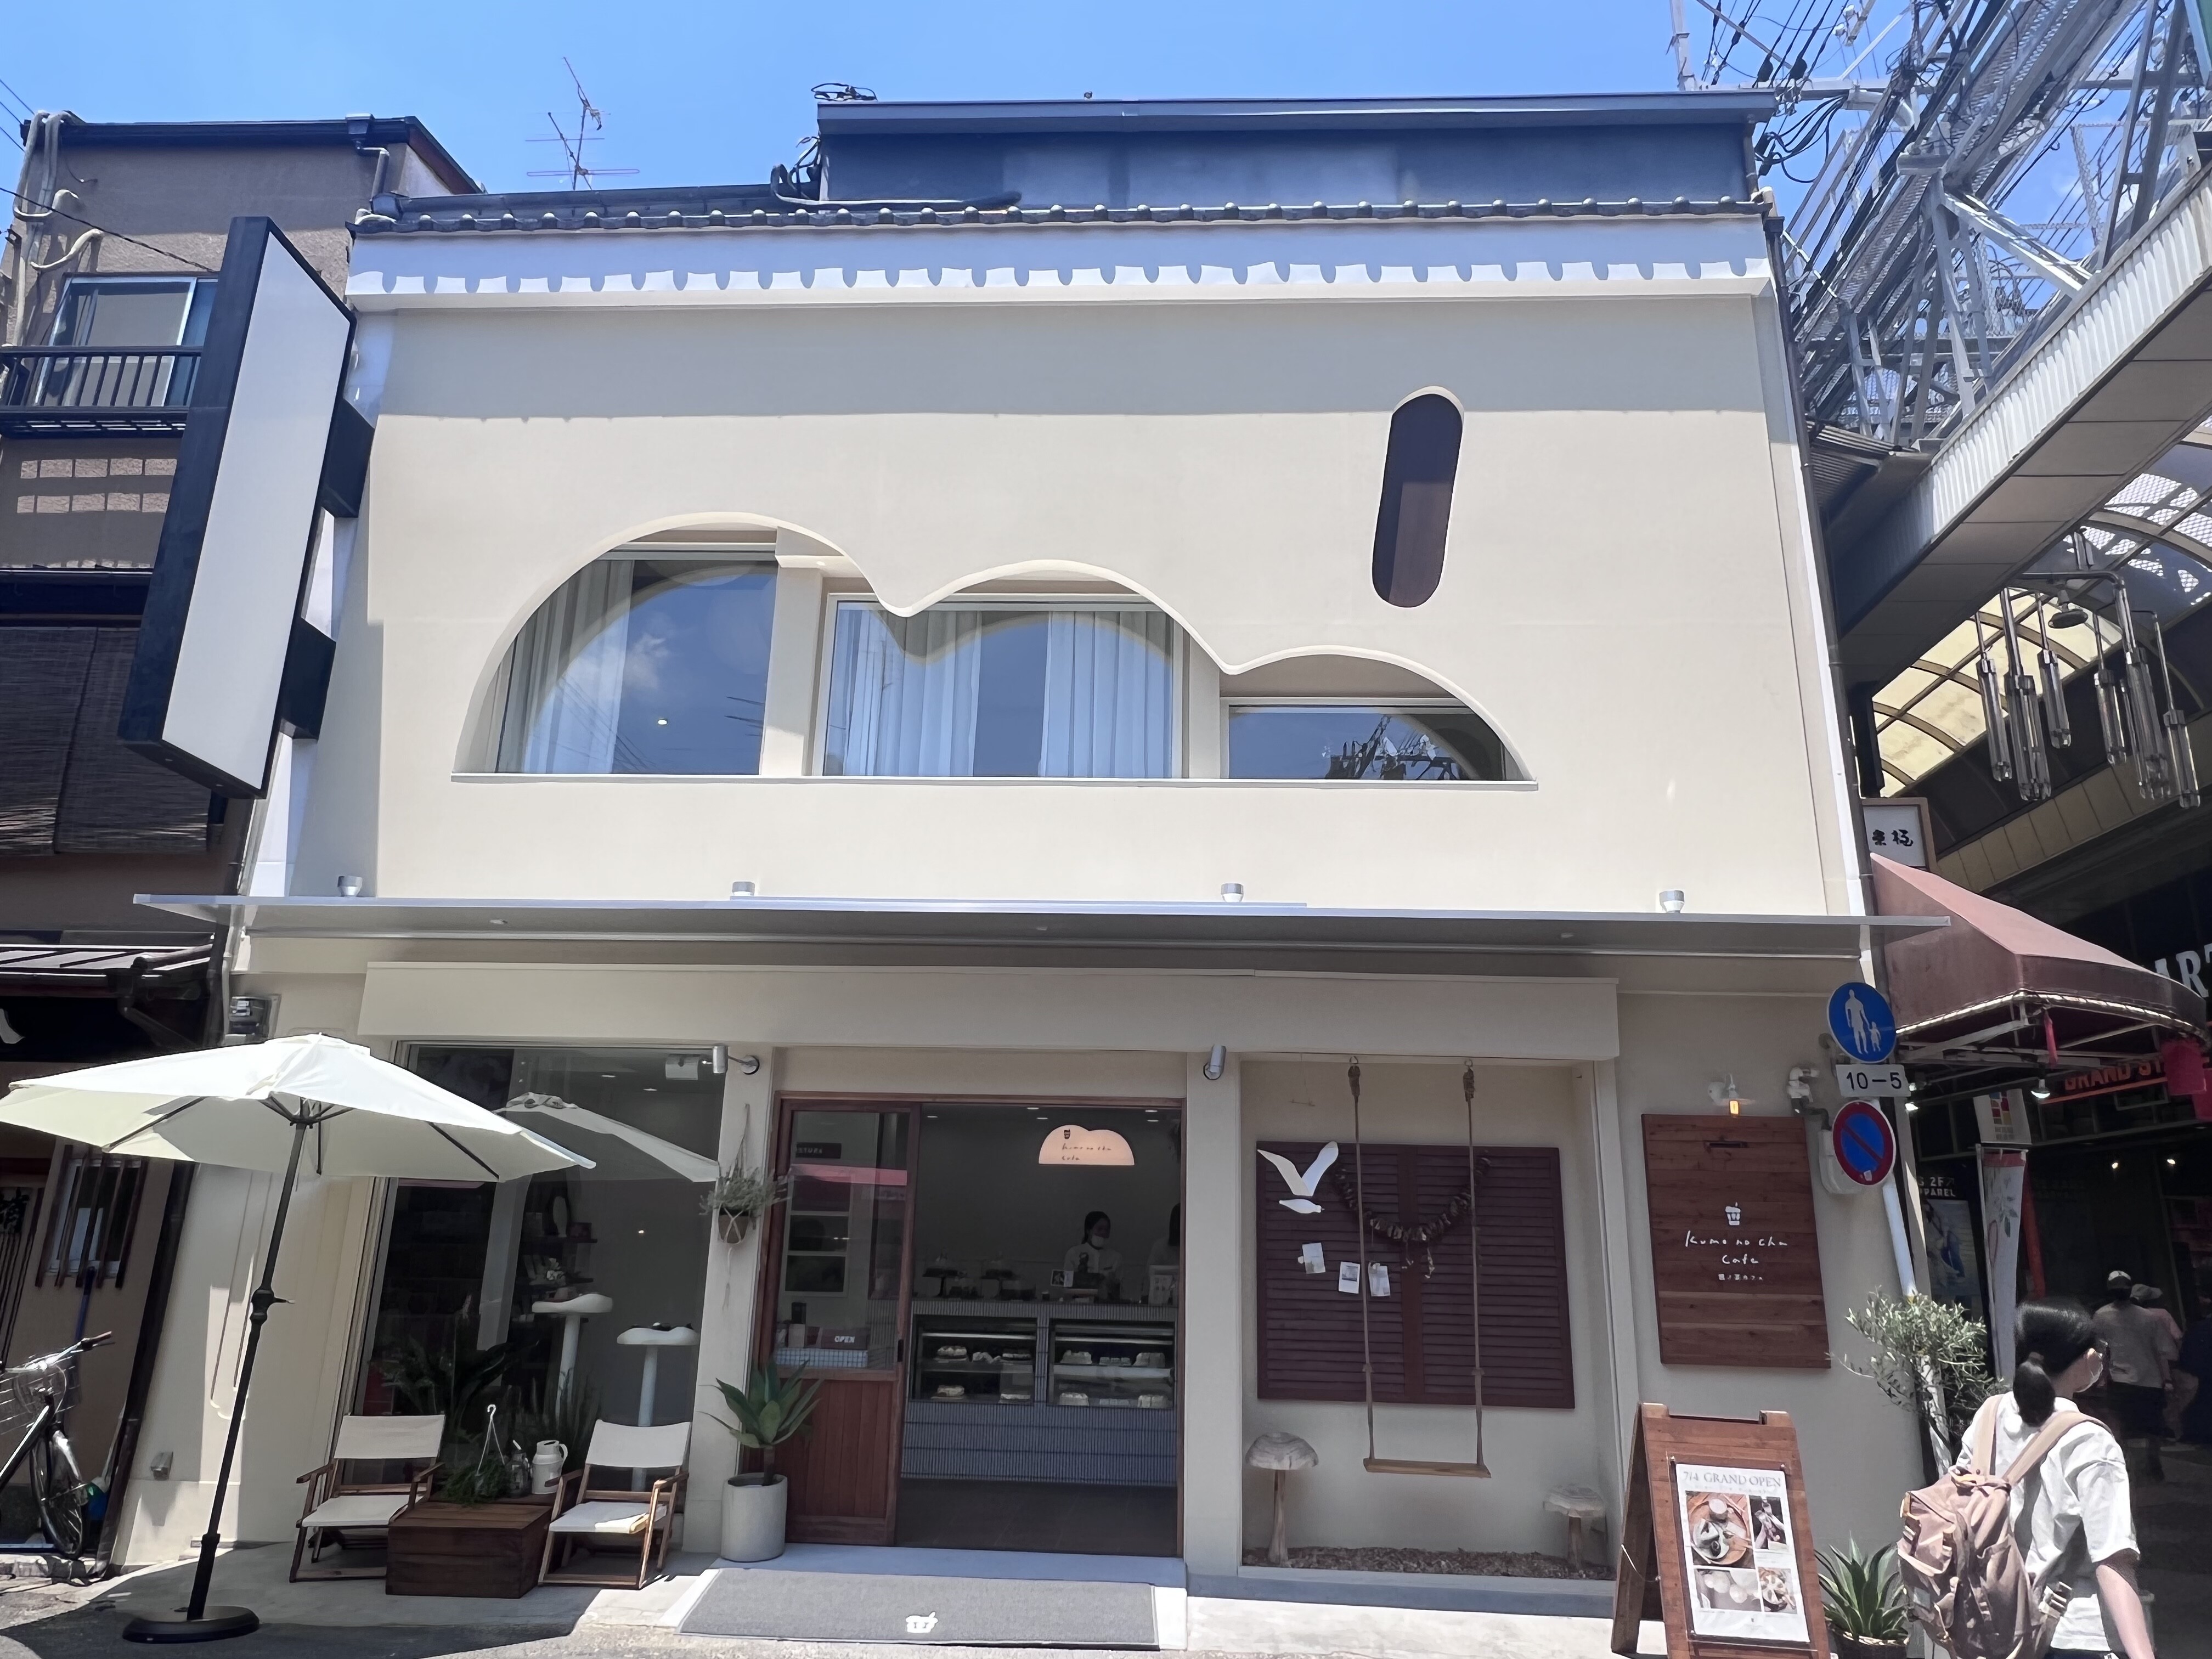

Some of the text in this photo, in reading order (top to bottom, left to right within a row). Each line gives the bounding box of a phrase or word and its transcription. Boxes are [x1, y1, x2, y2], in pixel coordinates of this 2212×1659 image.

[1846, 1071, 1902, 1091] 10-5
[1703, 1472, 1747, 1485] GRAND
[1748, 1476, 1781, 1487] OPEN
